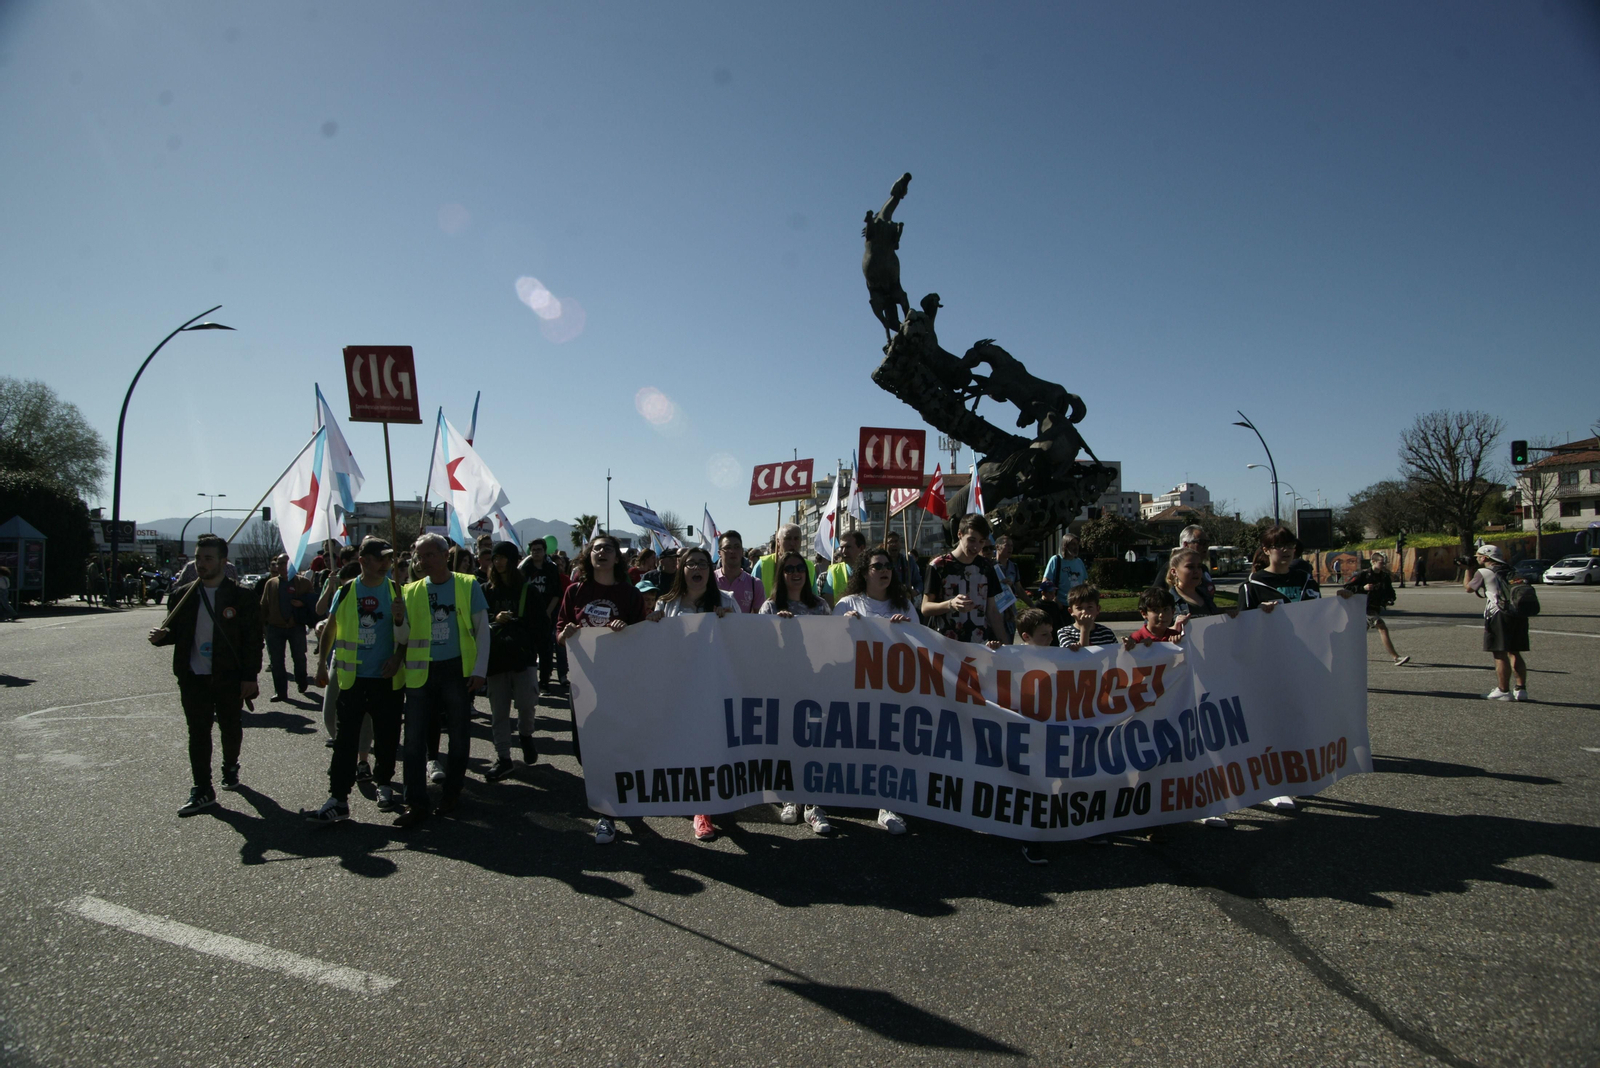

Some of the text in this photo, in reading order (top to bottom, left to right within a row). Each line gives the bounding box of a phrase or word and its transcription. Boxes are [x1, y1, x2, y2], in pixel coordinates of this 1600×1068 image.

[352, 353, 412, 400] CIG
[757, 464, 808, 491] CIG
[865, 434, 920, 471] CIG
[855, 640, 946, 697] NON
[955, 656, 986, 706] Á
[723, 692, 1250, 779] LEI GALEGA DE EDUCACIÓN
[615, 736, 1347, 829] PLATAFORMA GALEGA EN DEFENSA DO ENSINO PÚBLICO
